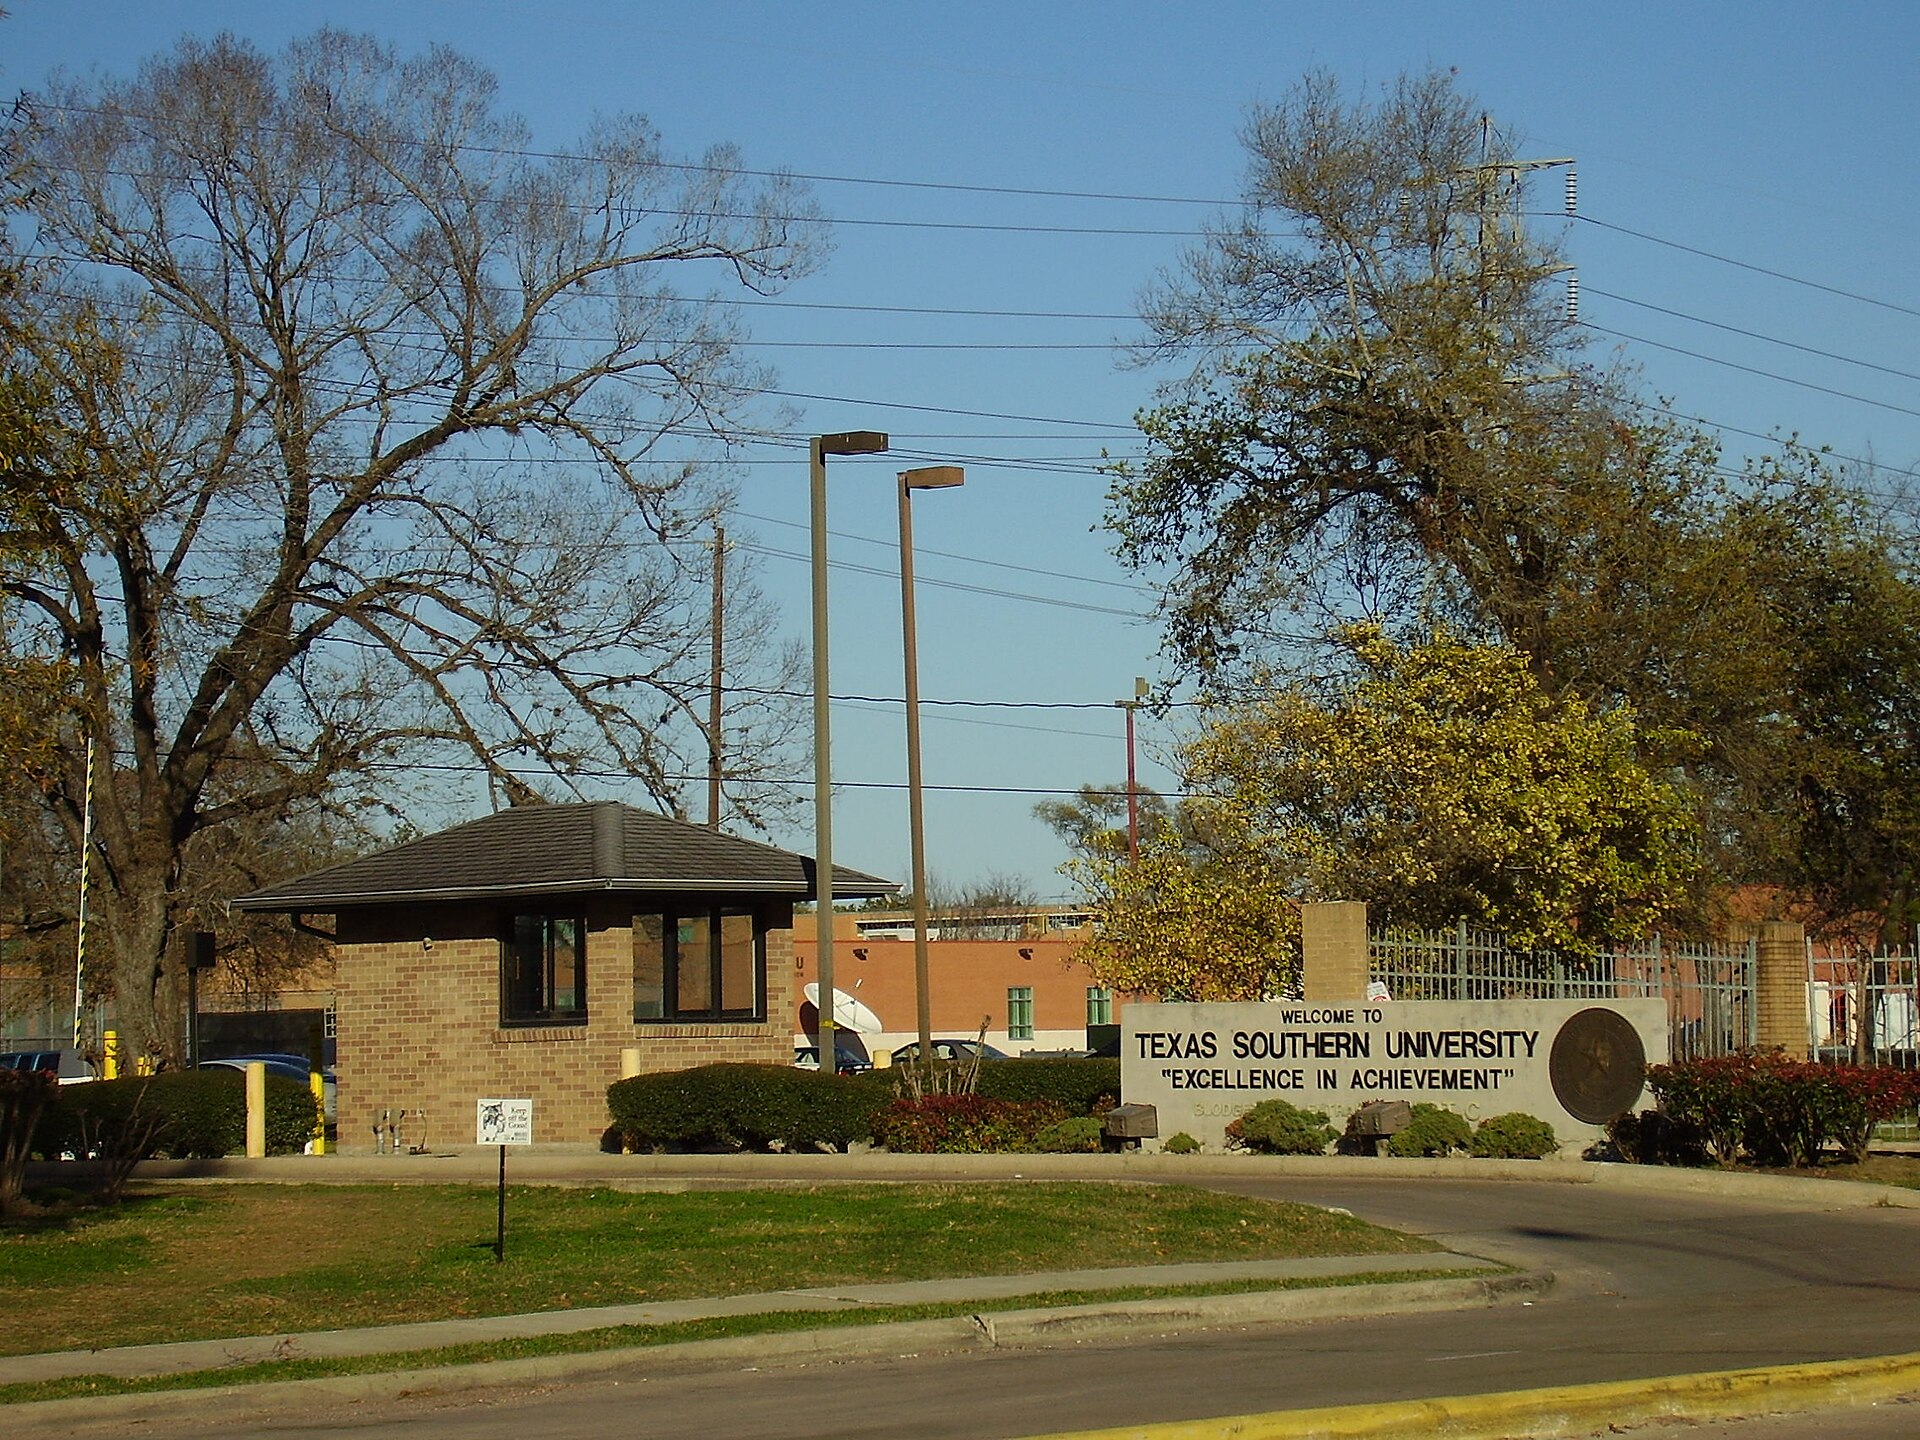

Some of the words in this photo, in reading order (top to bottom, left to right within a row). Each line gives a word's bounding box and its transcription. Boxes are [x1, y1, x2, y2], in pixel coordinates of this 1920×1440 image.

[1281, 1009, 1354, 1024] WELCOME
[1363, 1009, 1382, 1024] TO
[1135, 1031, 1217, 1059] TEXAS
[1233, 1031, 1370, 1059] SOUTHERN
[1386, 1030, 1539, 1059] UNIVERSITY
[1162, 1069, 1304, 1090] "EXCELLENCE
[1317, 1069, 1337, 1089] IN
[1350, 1069, 1514, 1090] ACHIEVEMENT"
